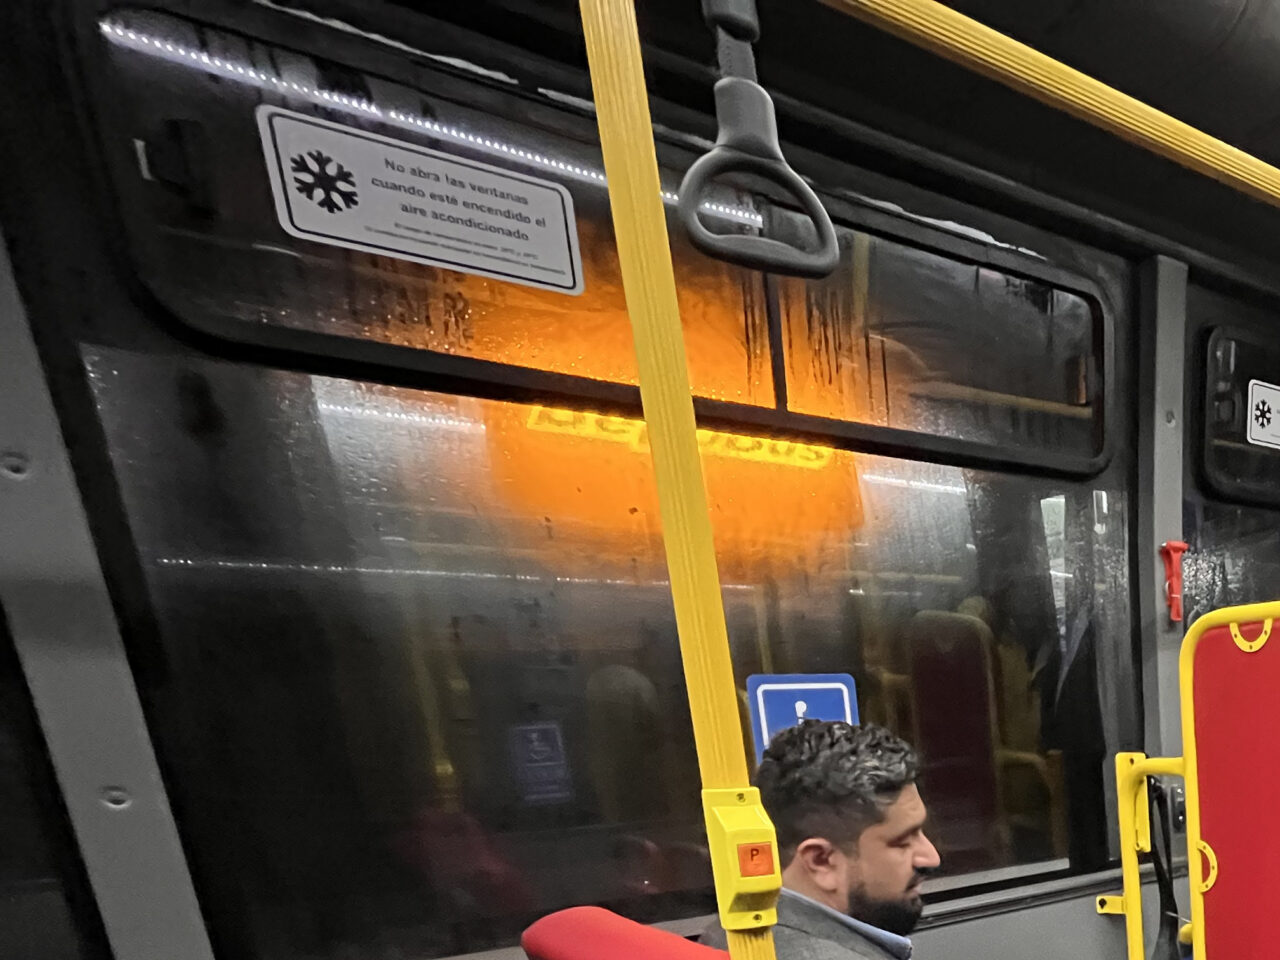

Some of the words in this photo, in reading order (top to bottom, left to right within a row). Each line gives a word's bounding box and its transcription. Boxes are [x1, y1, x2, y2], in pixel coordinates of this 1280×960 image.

[371, 176, 426, 198] cuando
[462, 201, 532, 224] encendido
[535, 216, 547, 228] el
[384, 157, 406, 173] No
[409, 166, 441, 183] abra
[445, 173, 466, 189] las
[469, 183, 529, 206] ventanas
[400, 202, 428, 218] aire
[431, 210, 530, 241] acondicionado
[750, 848, 760, 862] P
